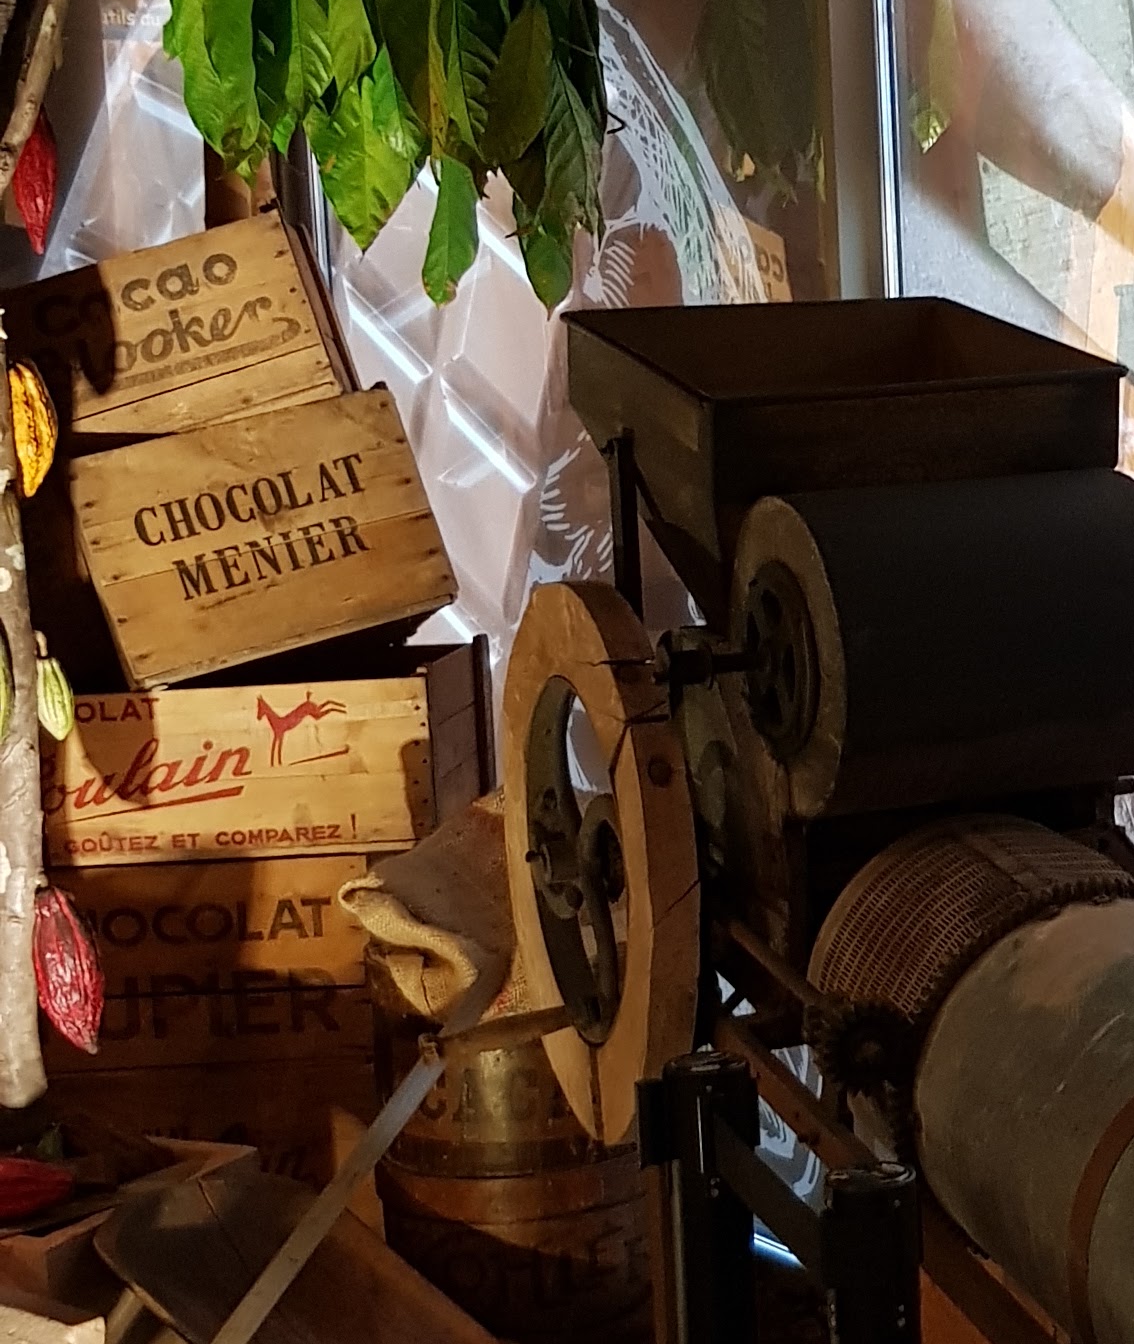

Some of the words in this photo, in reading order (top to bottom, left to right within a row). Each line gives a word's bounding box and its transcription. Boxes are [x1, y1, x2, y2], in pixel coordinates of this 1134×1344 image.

[133, 453, 366, 546] CHOCOLAT
[172, 515, 370, 601] MENIER
[74, 697, 160, 724] OLAT
[64, 828, 158, 855] GOÛTEZ
[172, 832, 201, 850] ET
[215, 823, 341, 847] COMPAREZ
[99, 967, 340, 1041] UPIER
